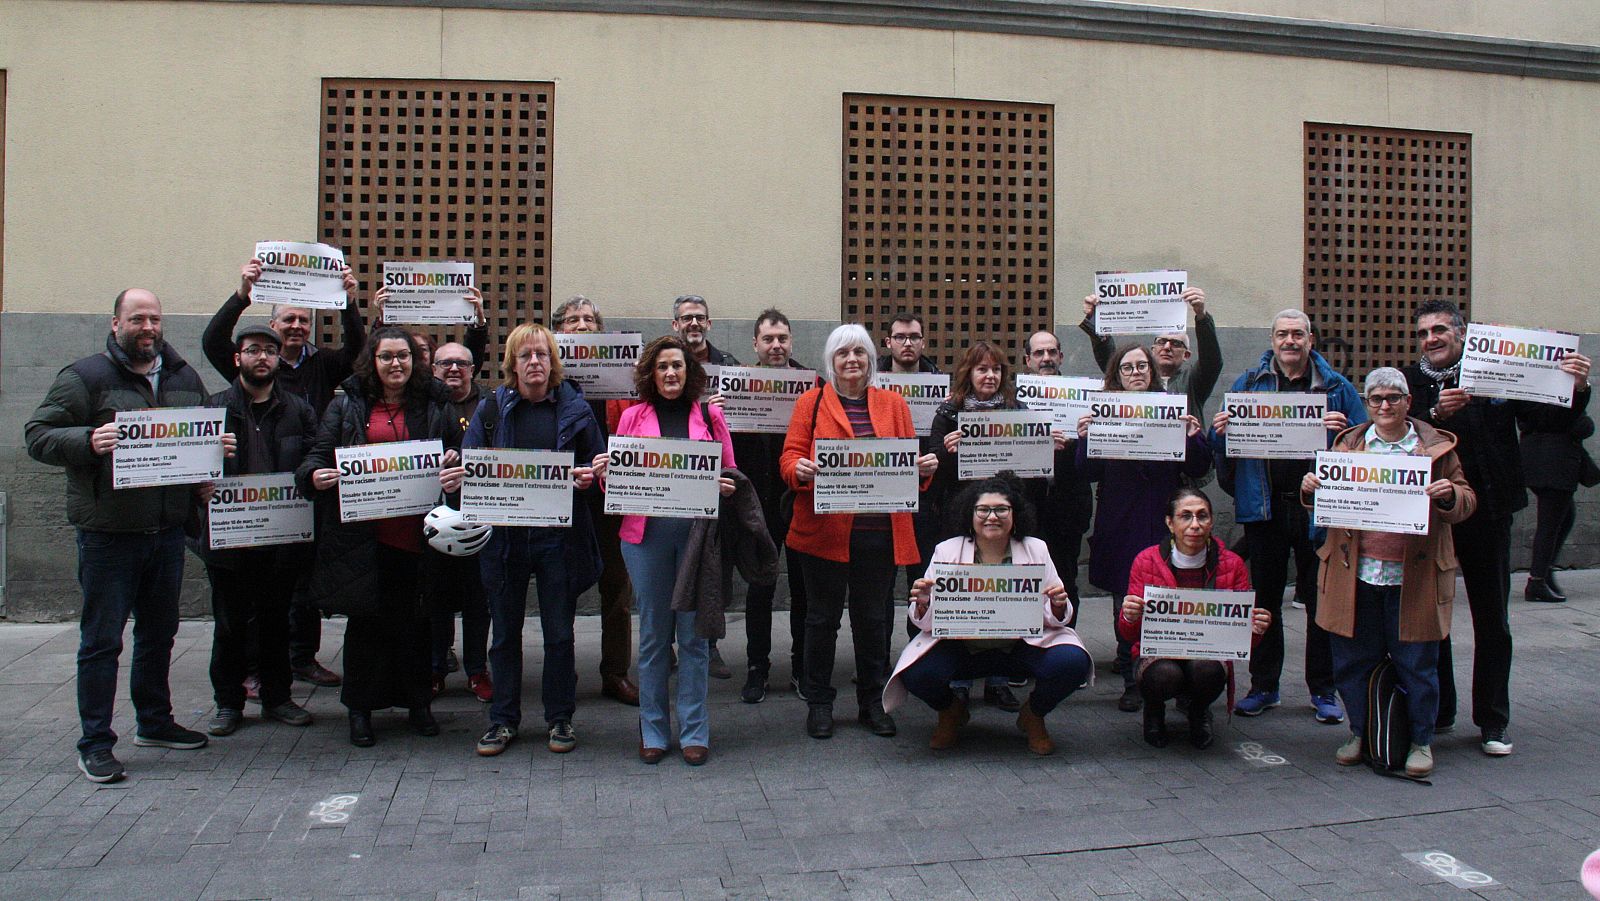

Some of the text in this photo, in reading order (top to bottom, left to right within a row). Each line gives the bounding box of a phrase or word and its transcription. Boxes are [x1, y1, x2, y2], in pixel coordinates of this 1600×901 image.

[385, 272, 472, 286] SOLIDARITAT
[1098, 282, 1184, 297] SOLIDARITAT
[1478, 354, 1501, 363] racisme
[721, 377, 813, 395] SOLIDARITAT
[1018, 385, 1089, 401] SOLIDARIT
[1090, 403, 1184, 420] SOLIDARITAT
[1227, 404, 1324, 419] SOLIDARITAT
[116, 420, 222, 440] SOLIDARITAT
[960, 423, 1052, 437] SOLIDARITAT
[130, 441, 153, 449] racisme
[339, 453, 441, 476] SOLIDARITAT
[609, 449, 718, 471] SOLIDARITAT
[817, 452, 917, 467] SOLIDARITAT
[464, 461, 571, 481] SOLIDARITAT
[623, 468, 645, 477] racisme
[1318, 464, 1428, 486] SOLIDARITAT
[1332, 482, 1354, 491] racisme
[211, 486, 303, 505] SOLIDARITA
[935, 577, 1042, 593] SOLIDARITAT
[1145, 599, 1252, 618] SOLIDARITAT
